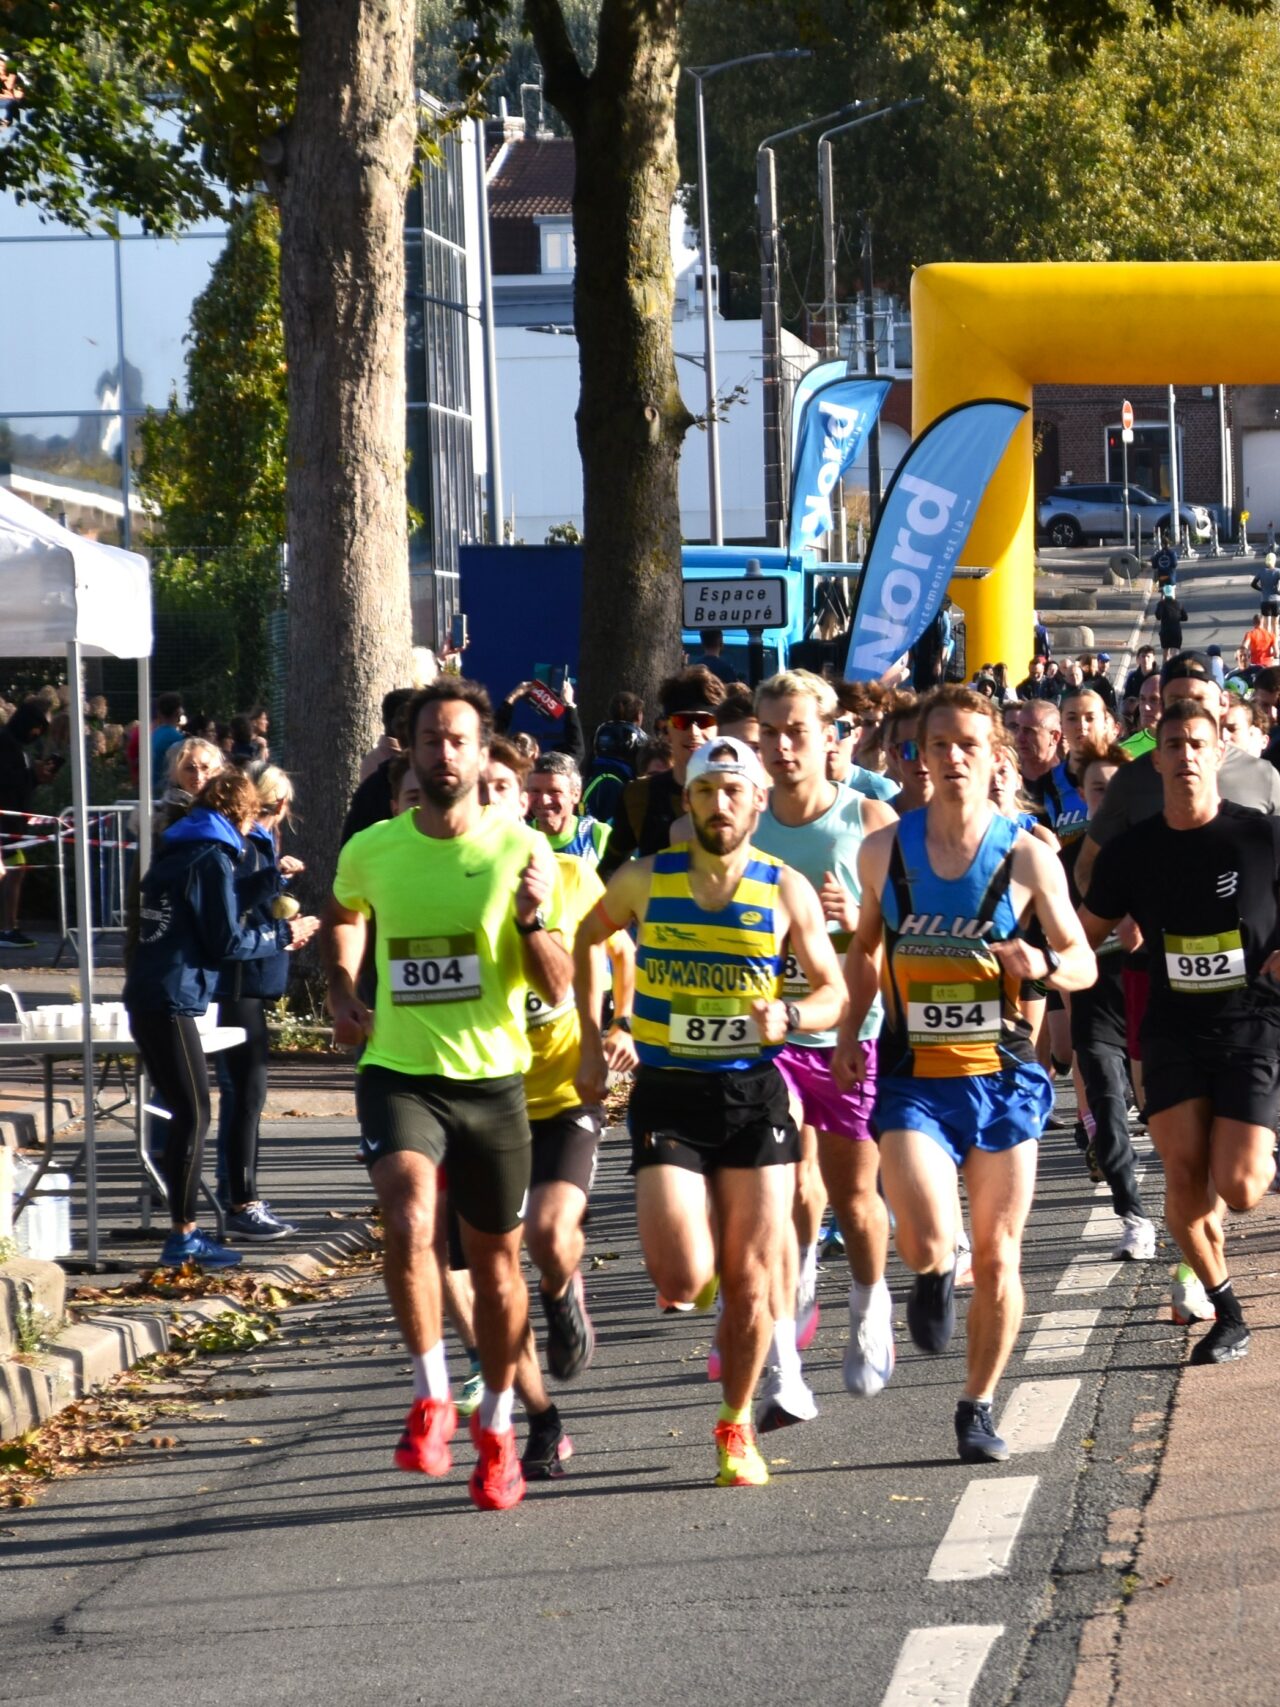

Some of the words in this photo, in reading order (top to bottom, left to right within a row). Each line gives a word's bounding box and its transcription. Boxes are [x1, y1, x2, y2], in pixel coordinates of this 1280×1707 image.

[852, 473, 958, 675] Nord
[699, 587, 767, 604] Espace
[694, 605, 773, 624] Beaupré
[899, 913, 995, 940] HLW
[403, 958, 464, 987] 804
[1178, 954, 1232, 977] 982
[923, 1003, 986, 1029] 954
[686, 1017, 747, 1042] 873
